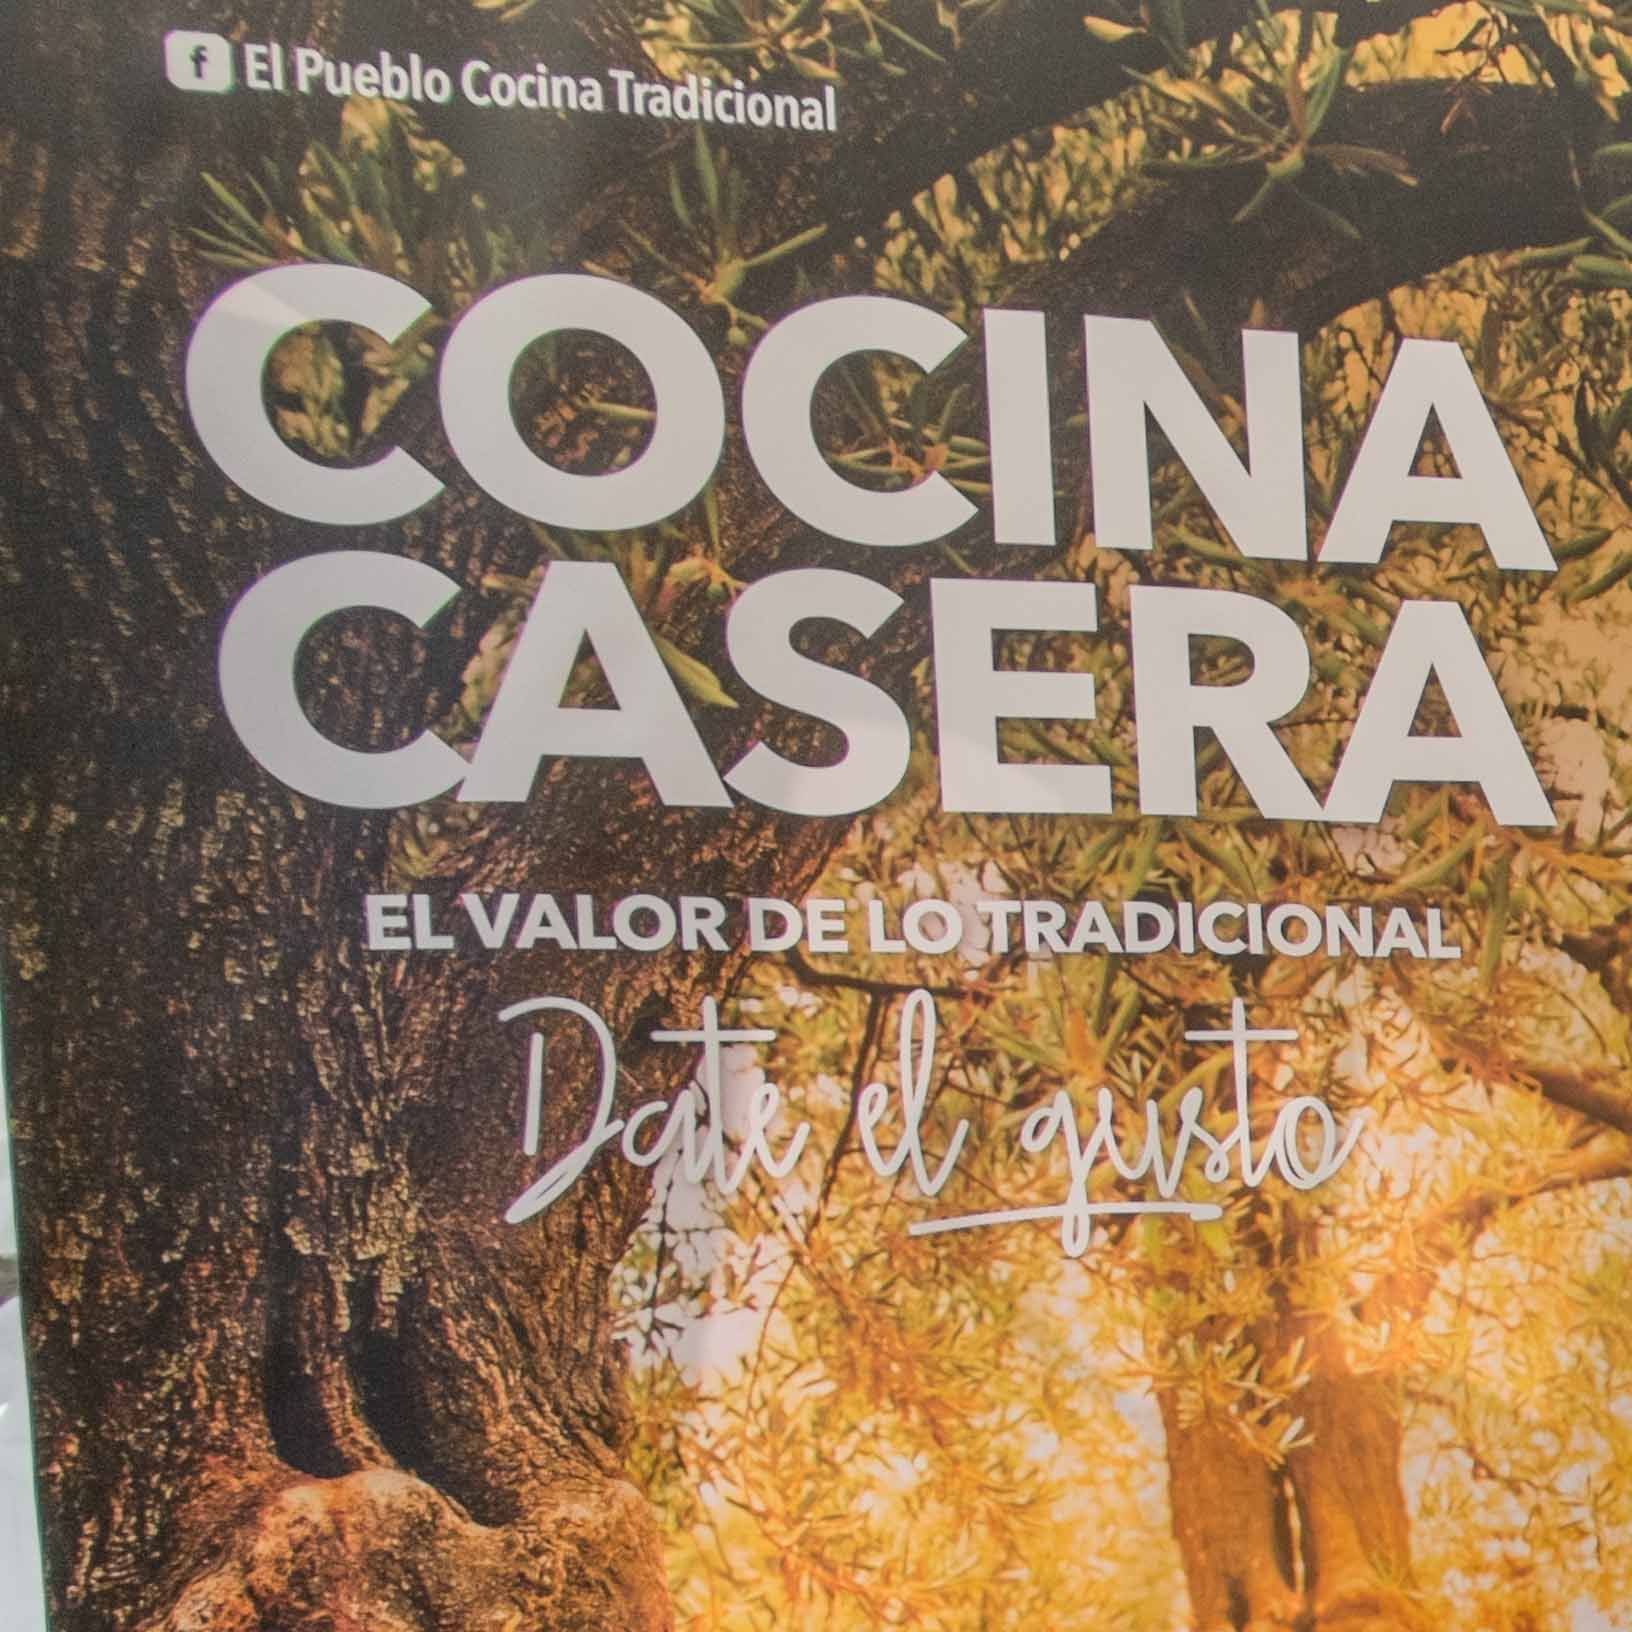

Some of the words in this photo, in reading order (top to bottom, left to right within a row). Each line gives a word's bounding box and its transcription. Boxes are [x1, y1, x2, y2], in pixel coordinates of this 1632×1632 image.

[244, 43, 282, 91] El
[297, 47, 452, 105] Pueblo
[461, 60, 604, 113] Cocina
[608, 68, 838, 132] Tradicional
[183, 263, 1557, 573] COCINA
[217, 548, 1557, 829] CASERA
[367, 894, 455, 951] EL
[460, 894, 730, 953] VALOR
[748, 899, 846, 954] DE
[870, 899, 964, 957] LO
[977, 900, 1463, 960] TRADICIONAL
[499, 996, 810, 1224] Date
[858, 987, 969, 1197] el
[1022, 998, 1366, 1258] gusto
